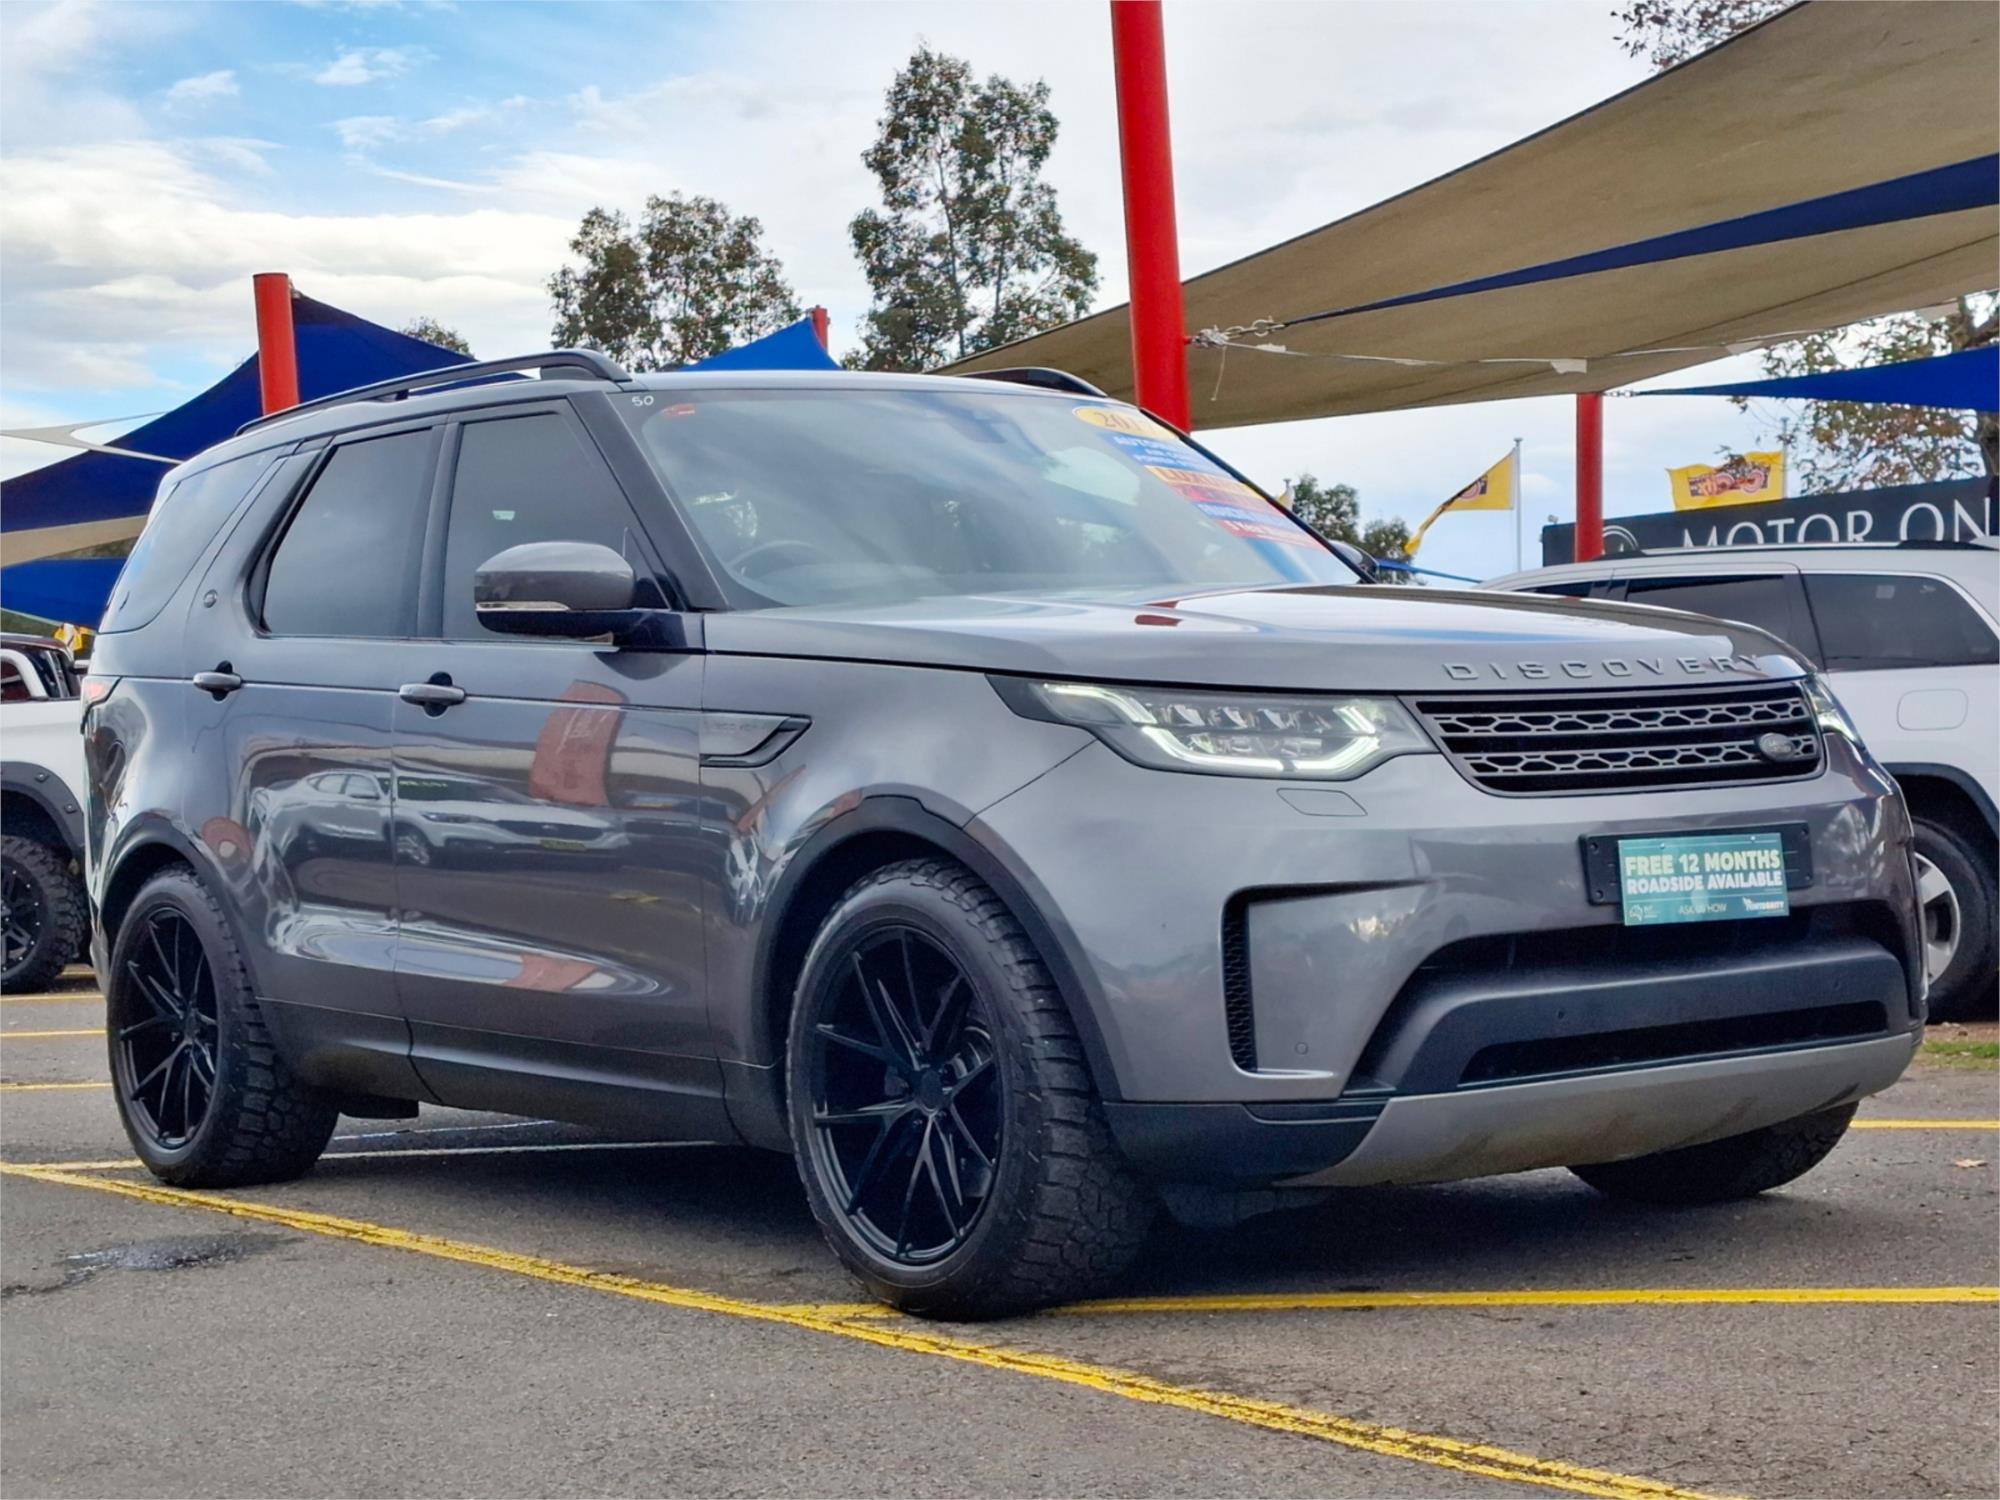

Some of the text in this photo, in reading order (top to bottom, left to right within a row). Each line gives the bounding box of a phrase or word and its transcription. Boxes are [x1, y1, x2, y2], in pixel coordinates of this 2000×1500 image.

[1684, 510, 1874, 547] MOTOR
[1442, 655, 1762, 680] DISCOVERY
[1625, 850, 1780, 875] FREE 12 MONTHS
[1627, 871, 1782, 894] ROADSIDE AVAILABLE
